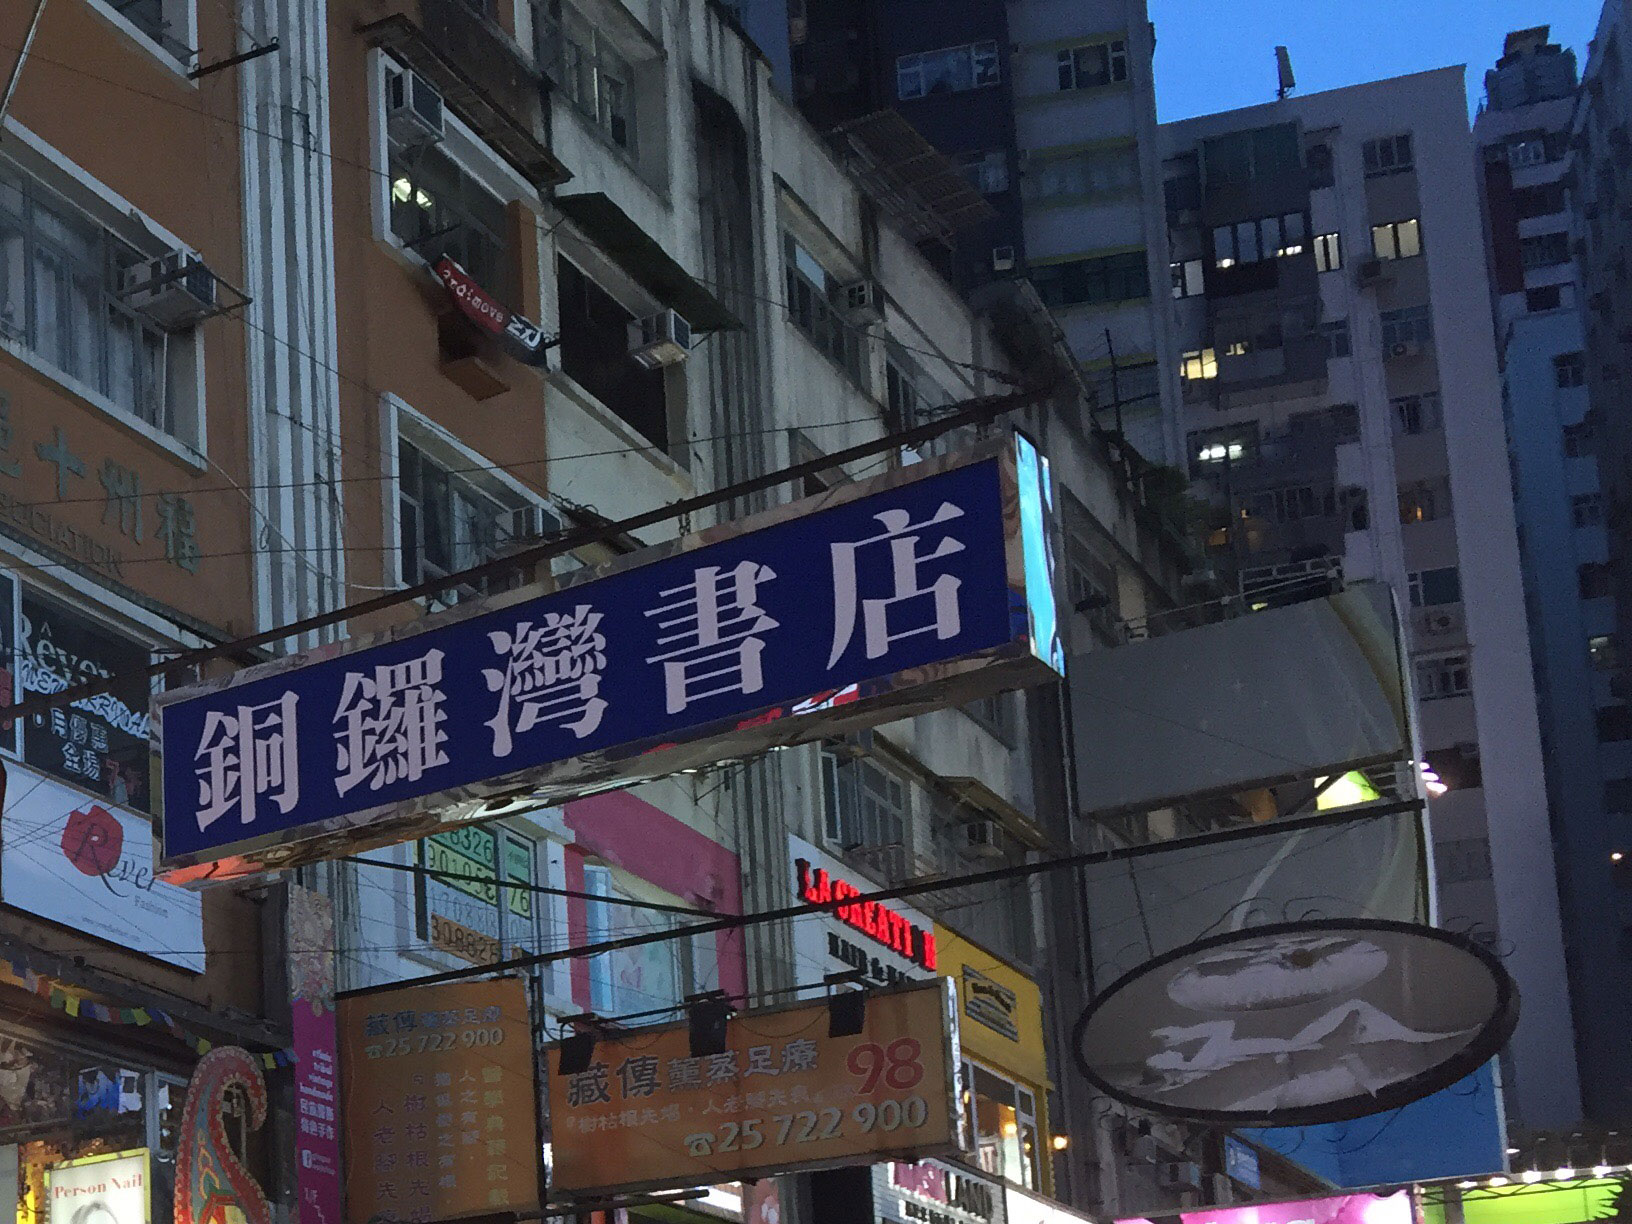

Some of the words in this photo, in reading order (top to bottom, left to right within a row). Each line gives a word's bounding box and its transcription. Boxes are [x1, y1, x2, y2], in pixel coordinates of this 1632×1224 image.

[194, 500, 968, 834] 銅鑼灣書店
[462, 1027, 505, 1049] 900
[846, 1037, 924, 1095] 98
[718, 1119, 765, 1151] 25
[773, 1107, 843, 1146] 722
[853, 1097, 929, 1132] 900
[54, 1179, 107, 1199] Person
[111, 1172, 143, 1192] Nail
